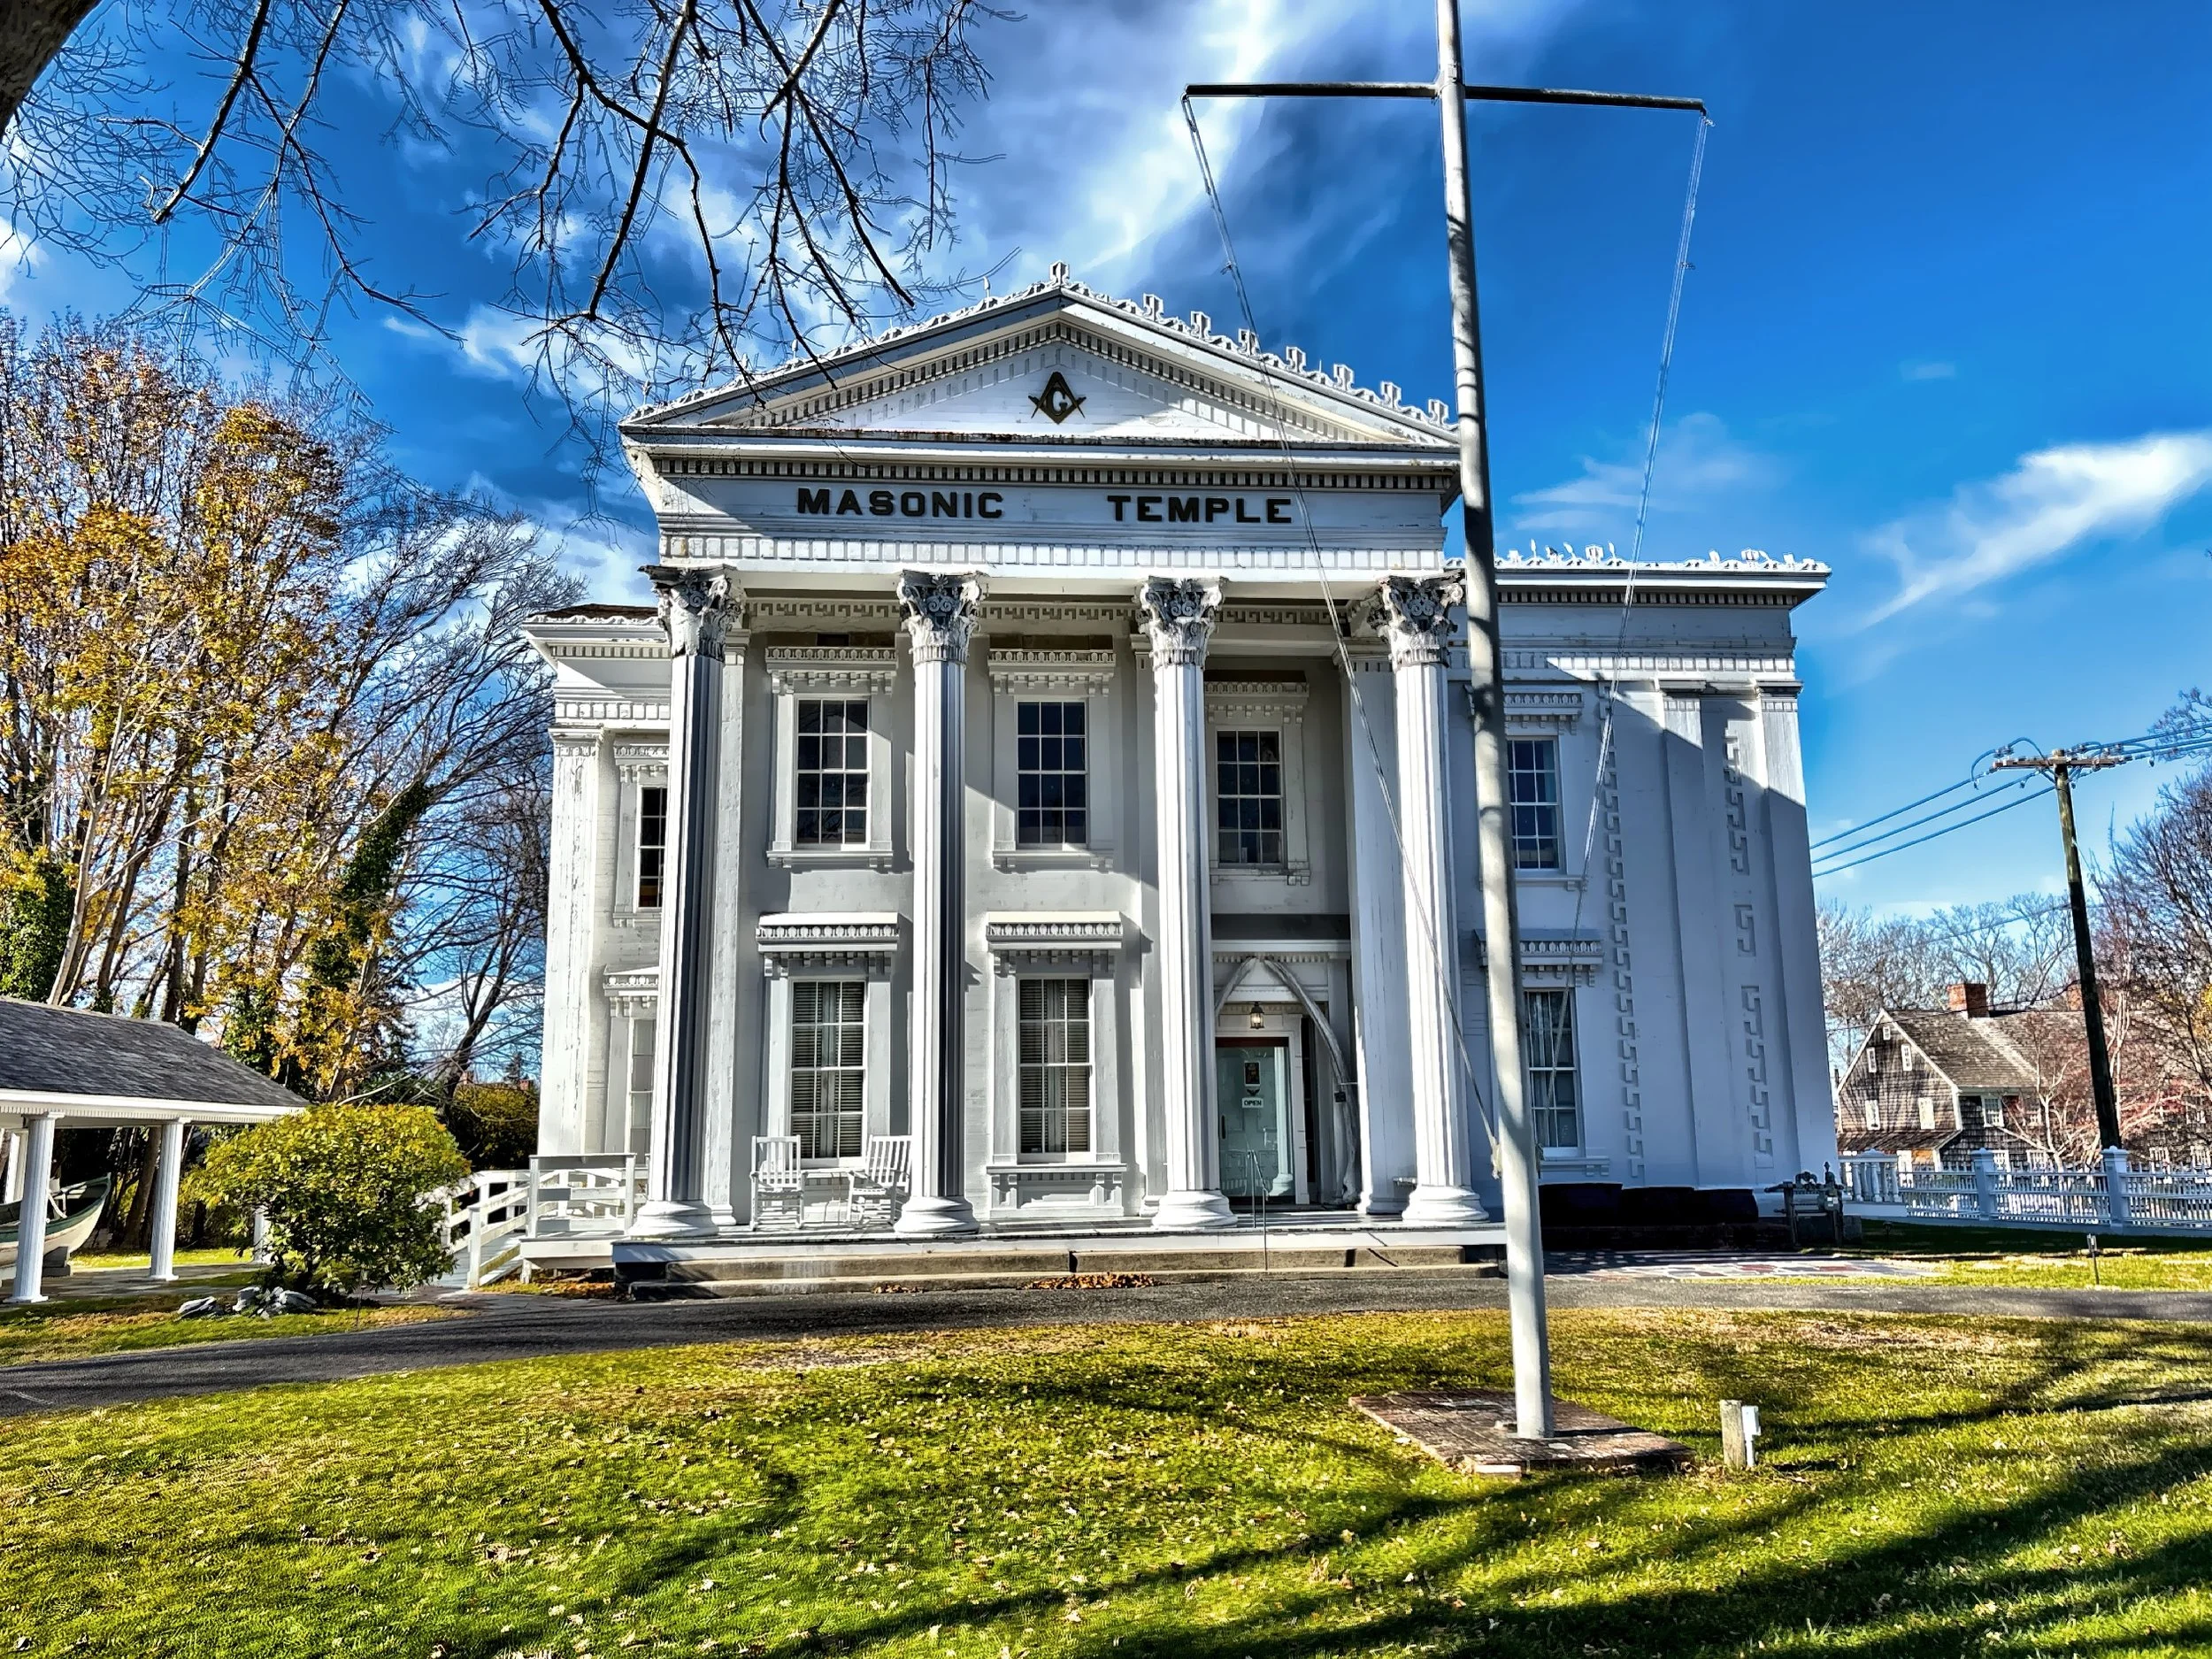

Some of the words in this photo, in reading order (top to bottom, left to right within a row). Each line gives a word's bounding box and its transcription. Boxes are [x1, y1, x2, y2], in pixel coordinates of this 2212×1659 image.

[1046, 388, 1068, 416] G
[797, 488, 1003, 518] MASONIC
[1107, 495, 1292, 523] TEMPLE
